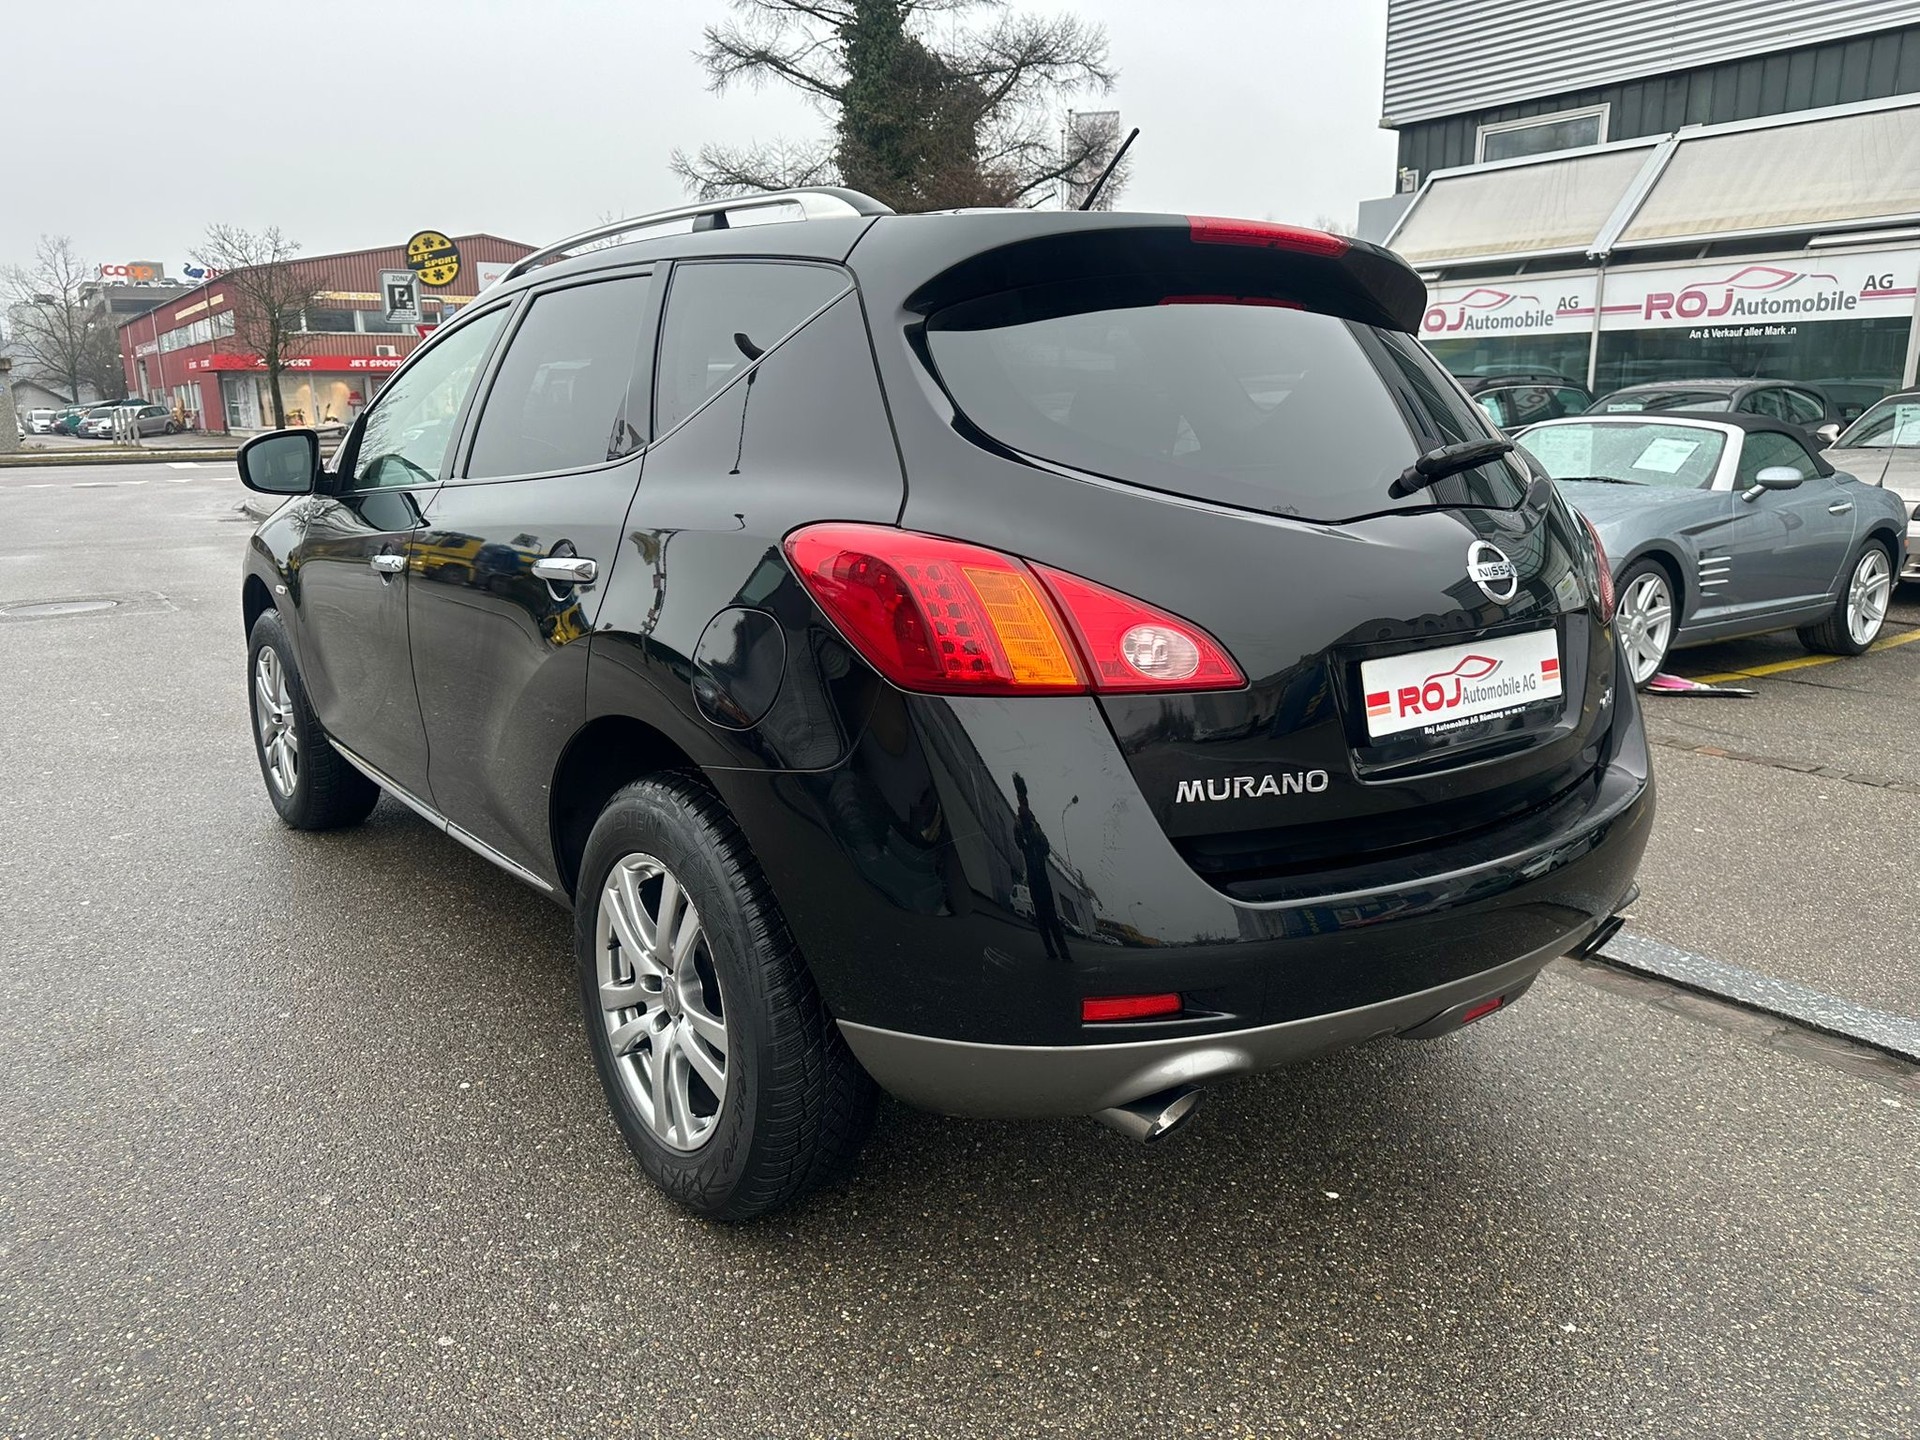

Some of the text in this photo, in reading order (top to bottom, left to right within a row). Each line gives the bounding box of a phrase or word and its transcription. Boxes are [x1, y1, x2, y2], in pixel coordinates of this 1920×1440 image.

[424, 255, 458, 268] SPORT
[1644, 274, 1894, 320] ROJ Automobile AG
[1424, 296, 1579, 333] OJ Automobile AG
[1689, 329, 1701, 339] An
[1702, 329, 1710, 338] &
[1711, 327, 1743, 338] Verkauf
[1744, 326, 1764, 337] aller
[349, 359, 402, 368] JET SPORT
[1398, 673, 1537, 718] ROJ Automobile AG
[1424, 726, 1435, 735] Roj
[1470, 715, 1479, 725] AG
[1175, 769, 1329, 803] MURANO
